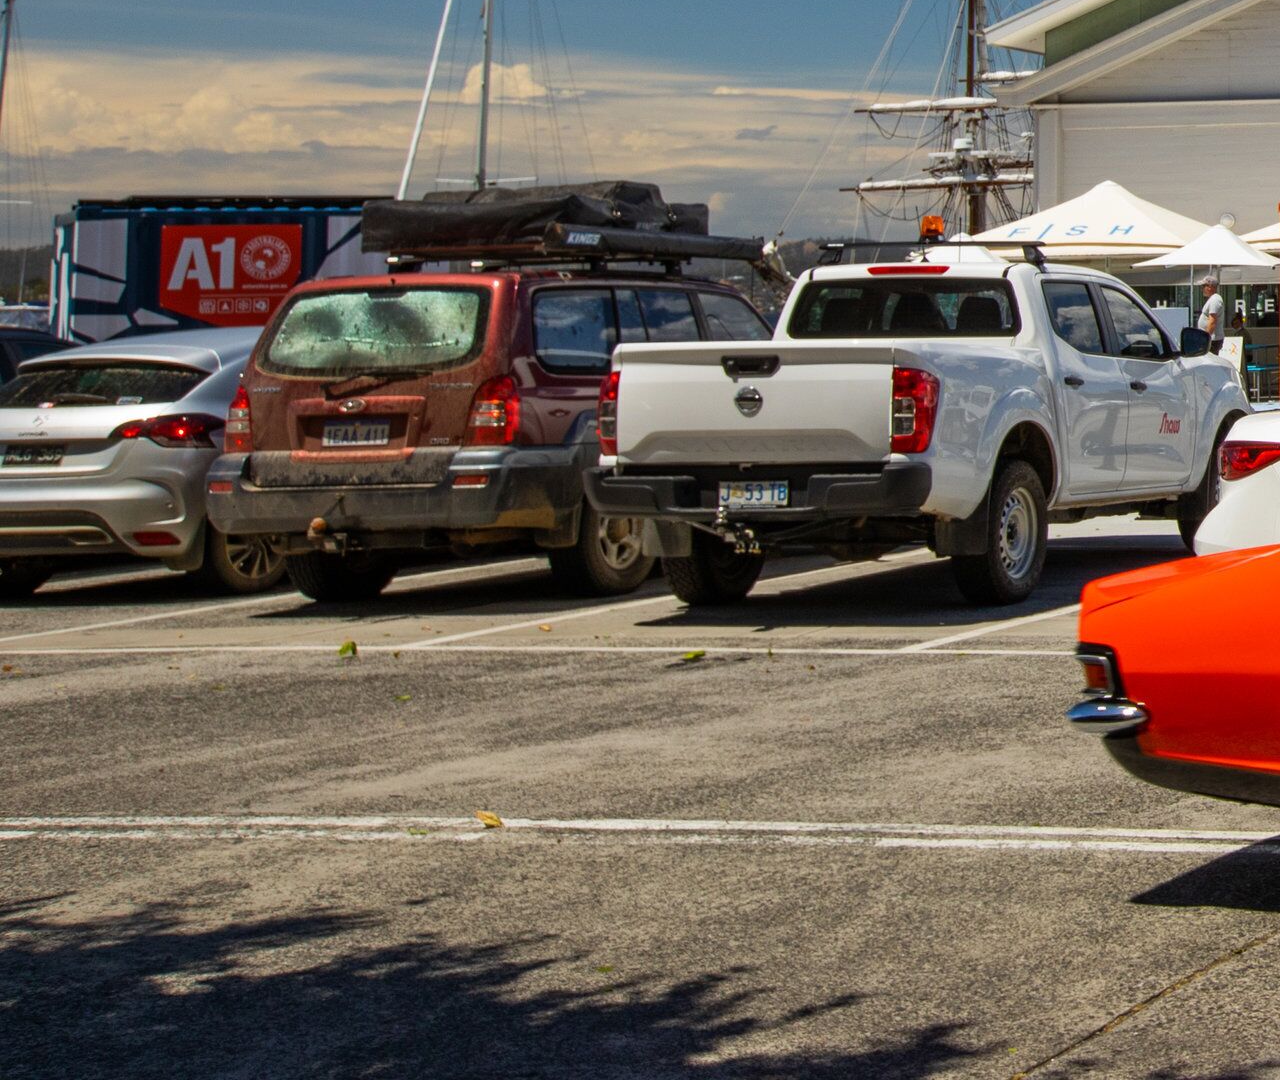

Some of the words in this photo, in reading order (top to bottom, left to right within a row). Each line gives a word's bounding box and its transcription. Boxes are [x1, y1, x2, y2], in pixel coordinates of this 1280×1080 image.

[566, 231, 601, 245] KINGS
[1008, 224, 1135, 239] FISH
[167, 236, 236, 291] A1
